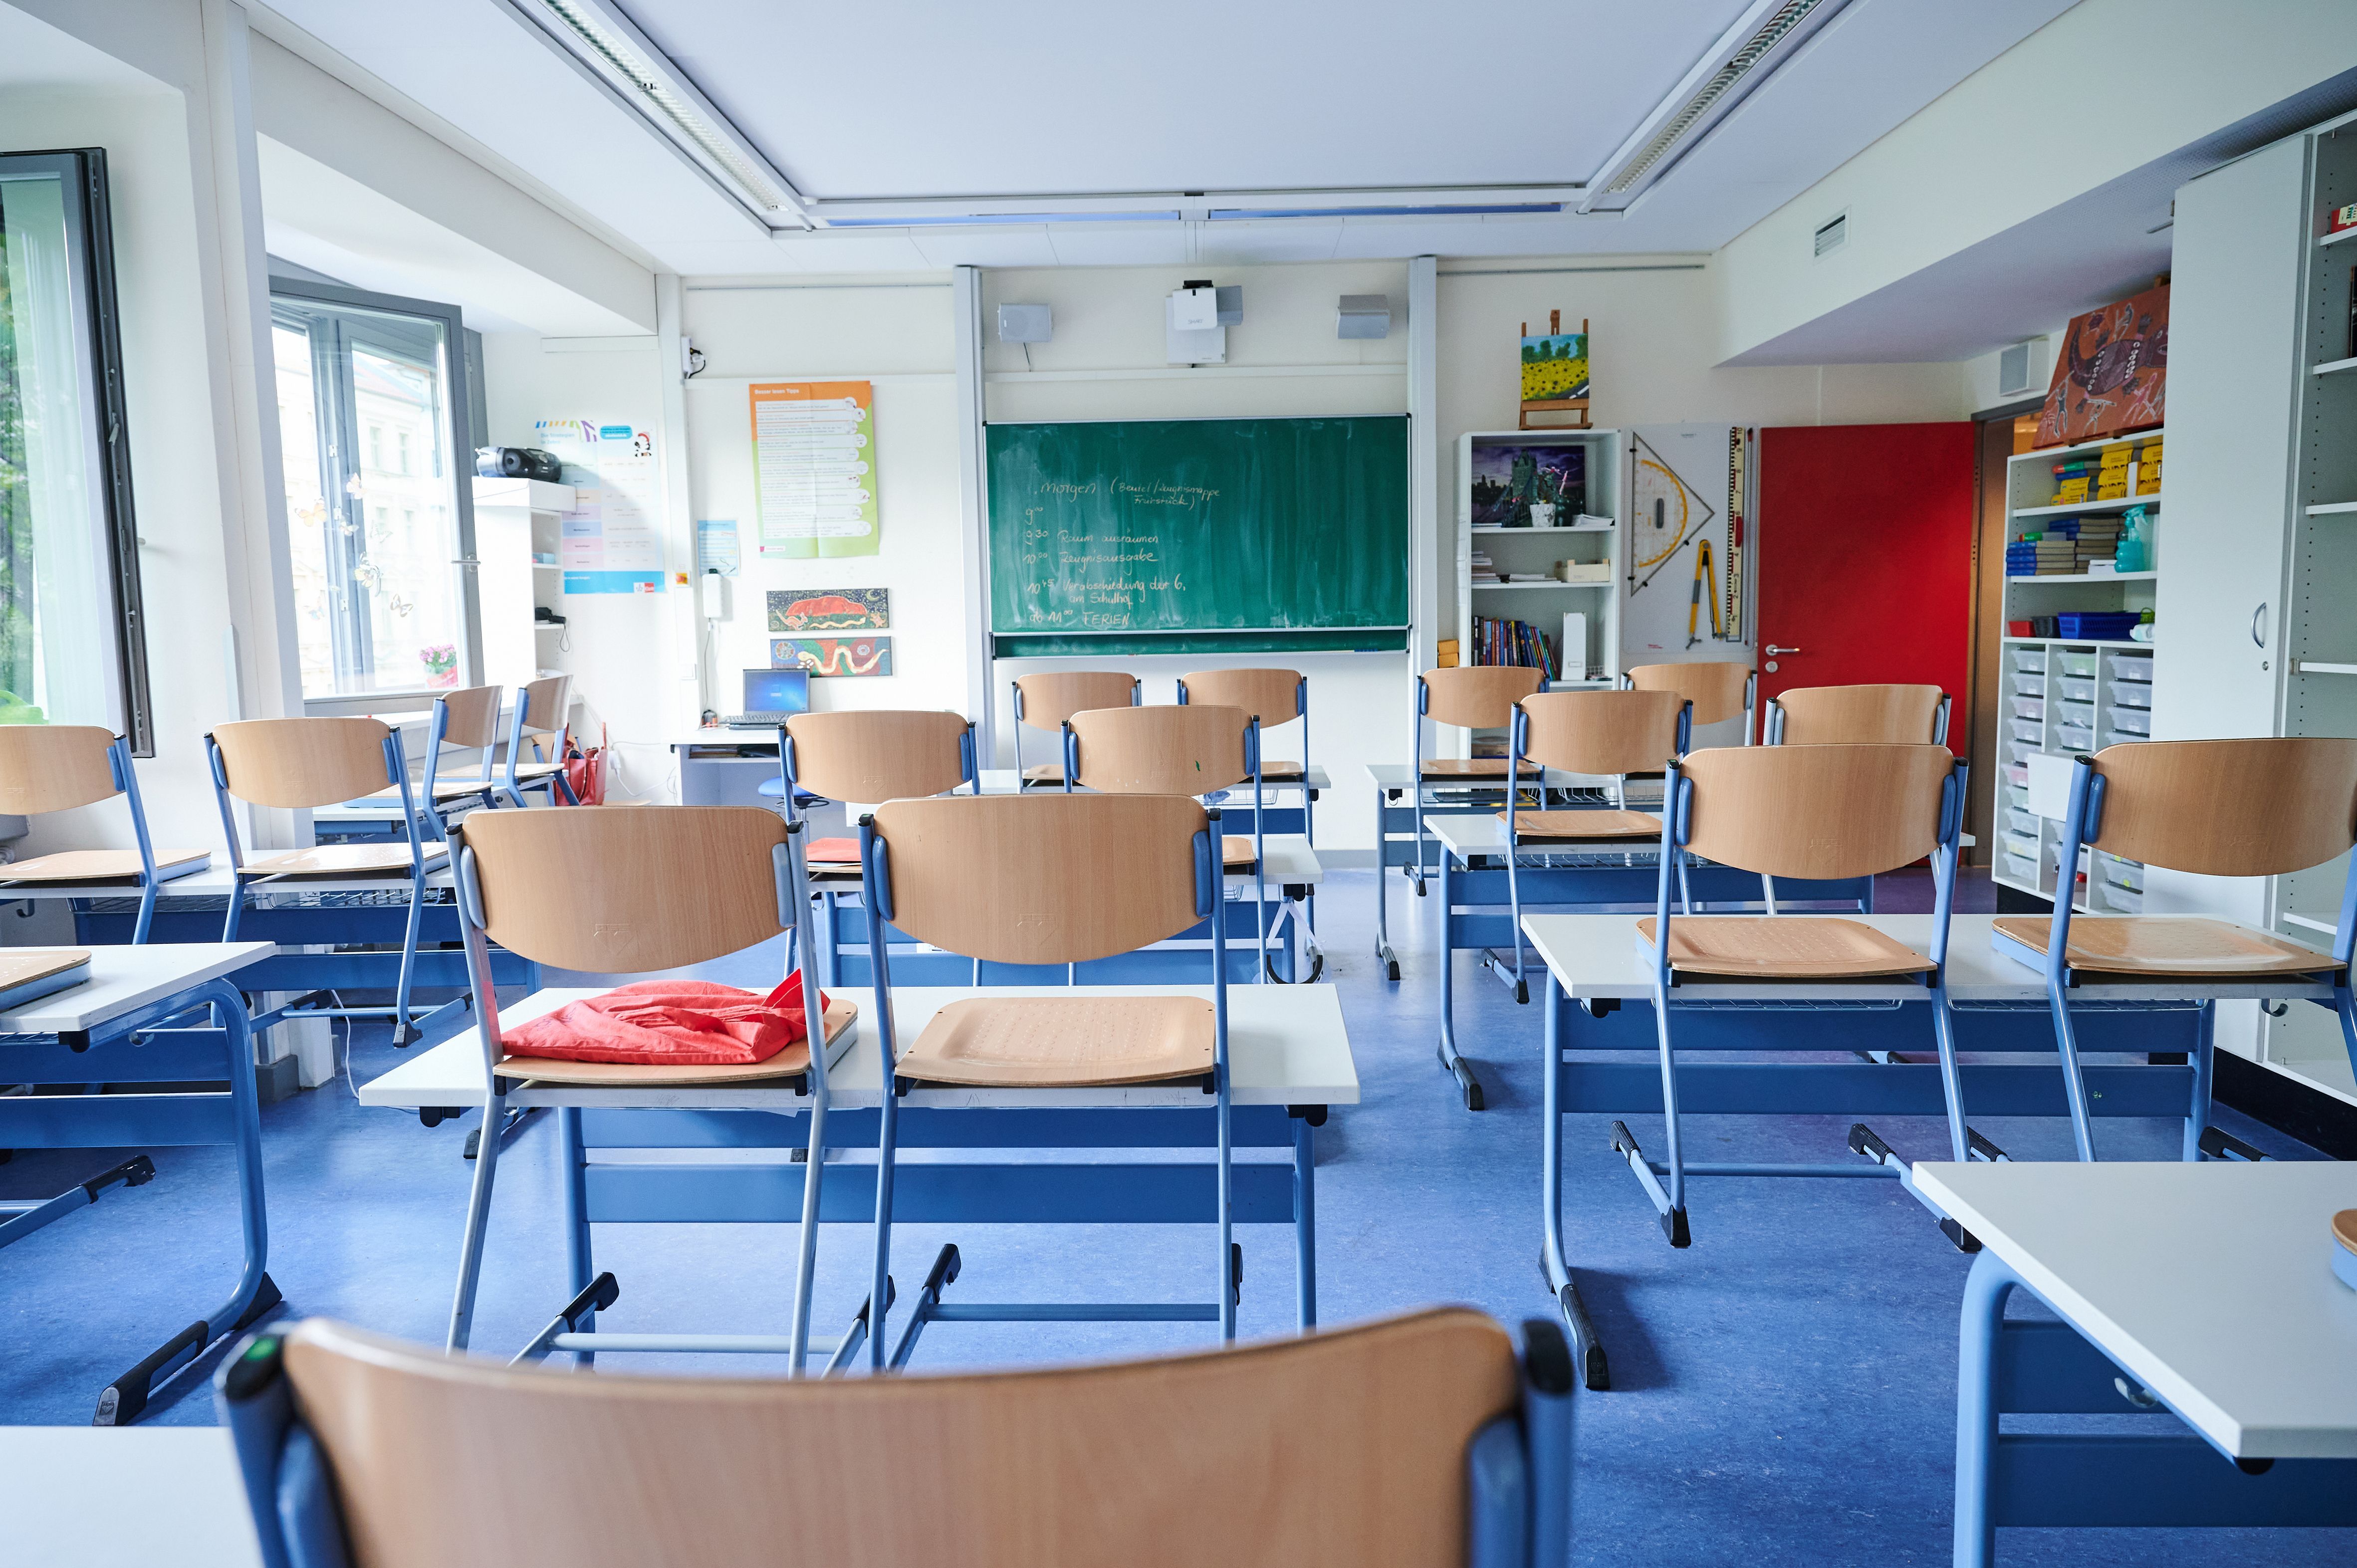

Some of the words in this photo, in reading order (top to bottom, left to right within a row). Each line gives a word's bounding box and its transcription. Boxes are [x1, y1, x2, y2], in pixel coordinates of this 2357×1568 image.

[1057, 529, 1094, 543] Raum
[1058, 548, 1159, 576] Zeugnisausgabe
[1063, 577, 1146, 603] Verabschiedung
[1150, 576, 1170, 591] der
[1090, 591, 1134, 610] Schulhof
[1029, 608, 1043, 623] ab
[1083, 611, 1131, 626] FERIEN
